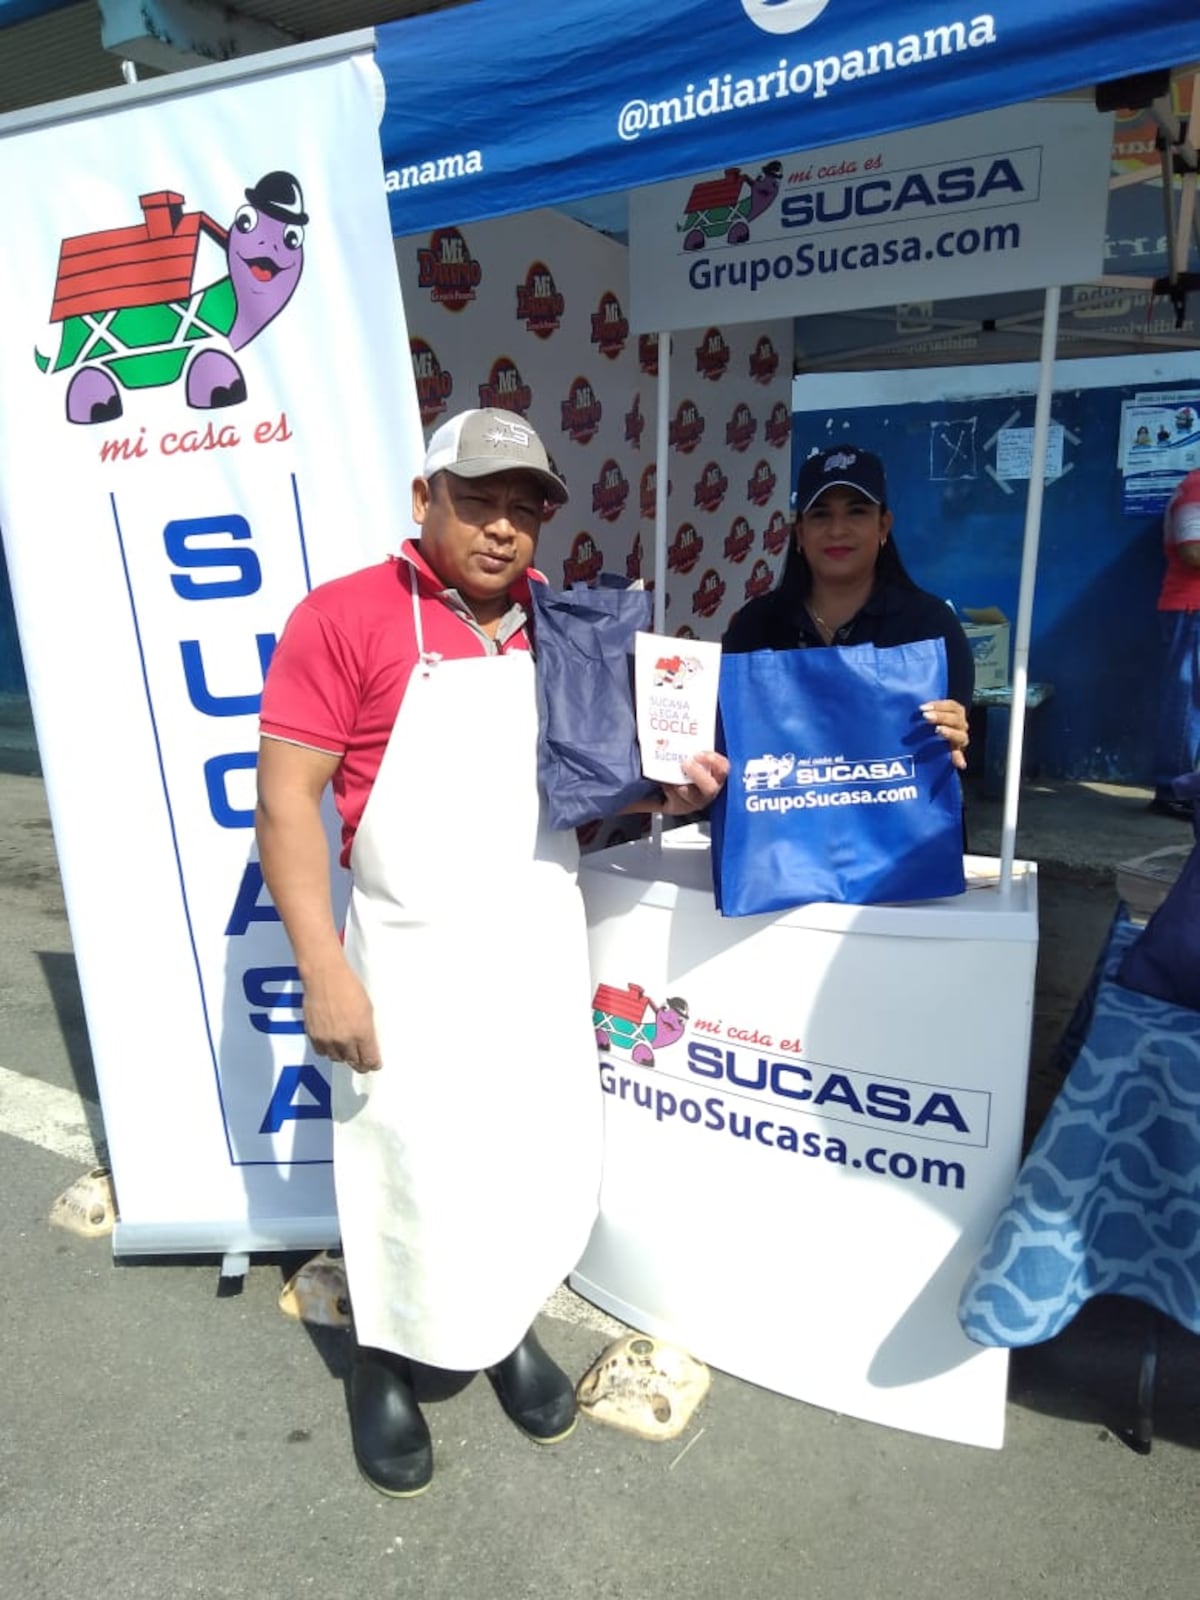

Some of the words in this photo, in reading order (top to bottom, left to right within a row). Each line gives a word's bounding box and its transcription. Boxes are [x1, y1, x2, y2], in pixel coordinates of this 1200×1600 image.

[617, 13, 997, 141] @midiariopanama
[788, 167, 812, 184] mi
[818, 161, 858, 178] casa
[865, 154, 883, 171] es
[781, 158, 1023, 228] SUCASA
[440, 237, 464, 263] Mi
[689, 221, 1020, 290] GrupoSucasa.com
[533, 275, 551, 297] Mi
[605, 303, 619, 322] Mi
[498, 369, 517, 393] Mi
[576, 387, 591, 409] Mi
[100, 424, 147, 463] mi
[159, 419, 241, 453] casa
[254, 411, 293, 443] es
[578, 540, 592, 564] Mi
[796, 761, 907, 785] SUCASA
[745, 785, 918, 813] GrupoSucasa.com
[693, 1017, 722, 1035] mi
[726, 1024, 774, 1047] casa
[780, 1038, 803, 1054] es
[687, 1041, 971, 1134] SUCASA
[598, 1061, 966, 1190] GrupoSucasa.com
